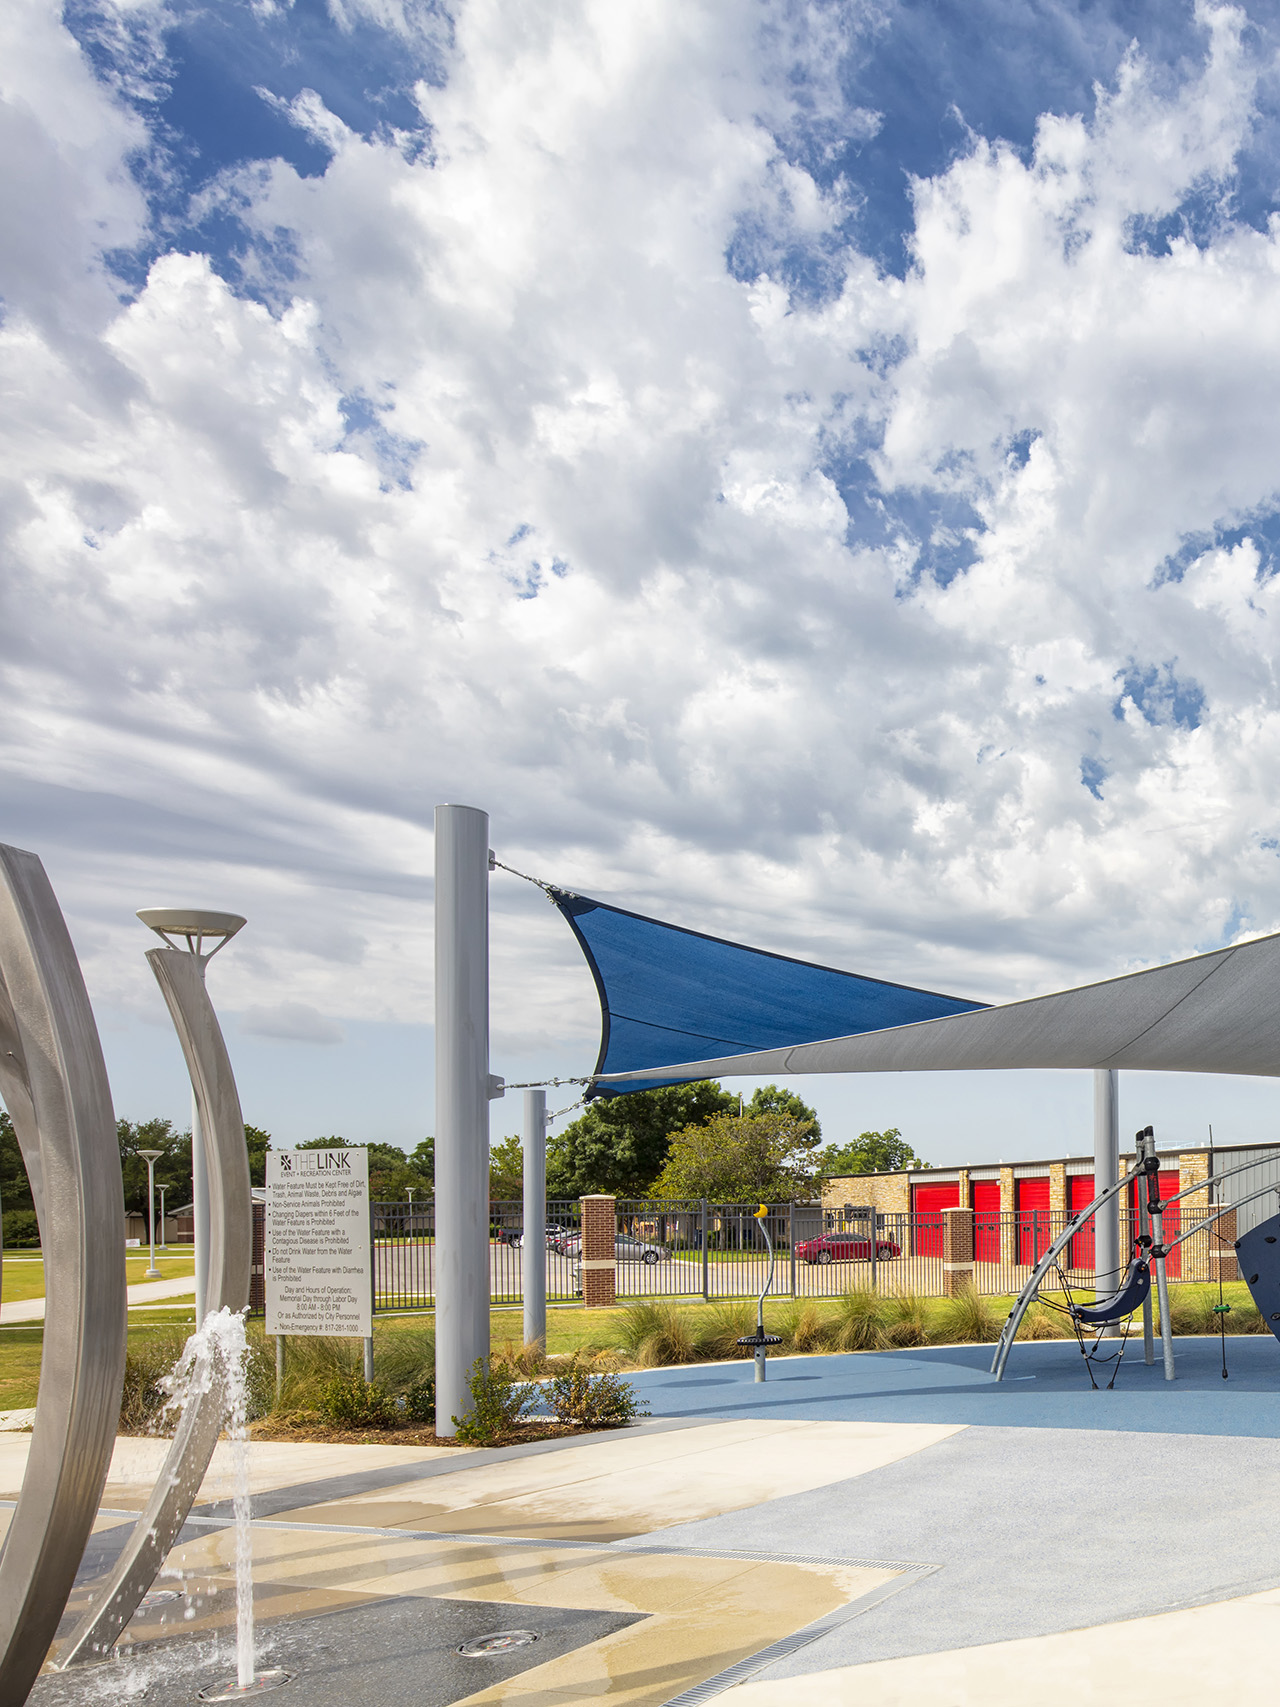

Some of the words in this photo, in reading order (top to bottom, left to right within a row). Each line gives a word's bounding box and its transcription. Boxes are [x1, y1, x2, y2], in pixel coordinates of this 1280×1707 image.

[348, 1189, 362, 1198] Algae
[272, 1211, 294, 1219] Changing
[285, 1286, 294, 1294] Day
[348, 1295, 357, 1304] Day
[280, 1323, 318, 1332] Non-Emergency
